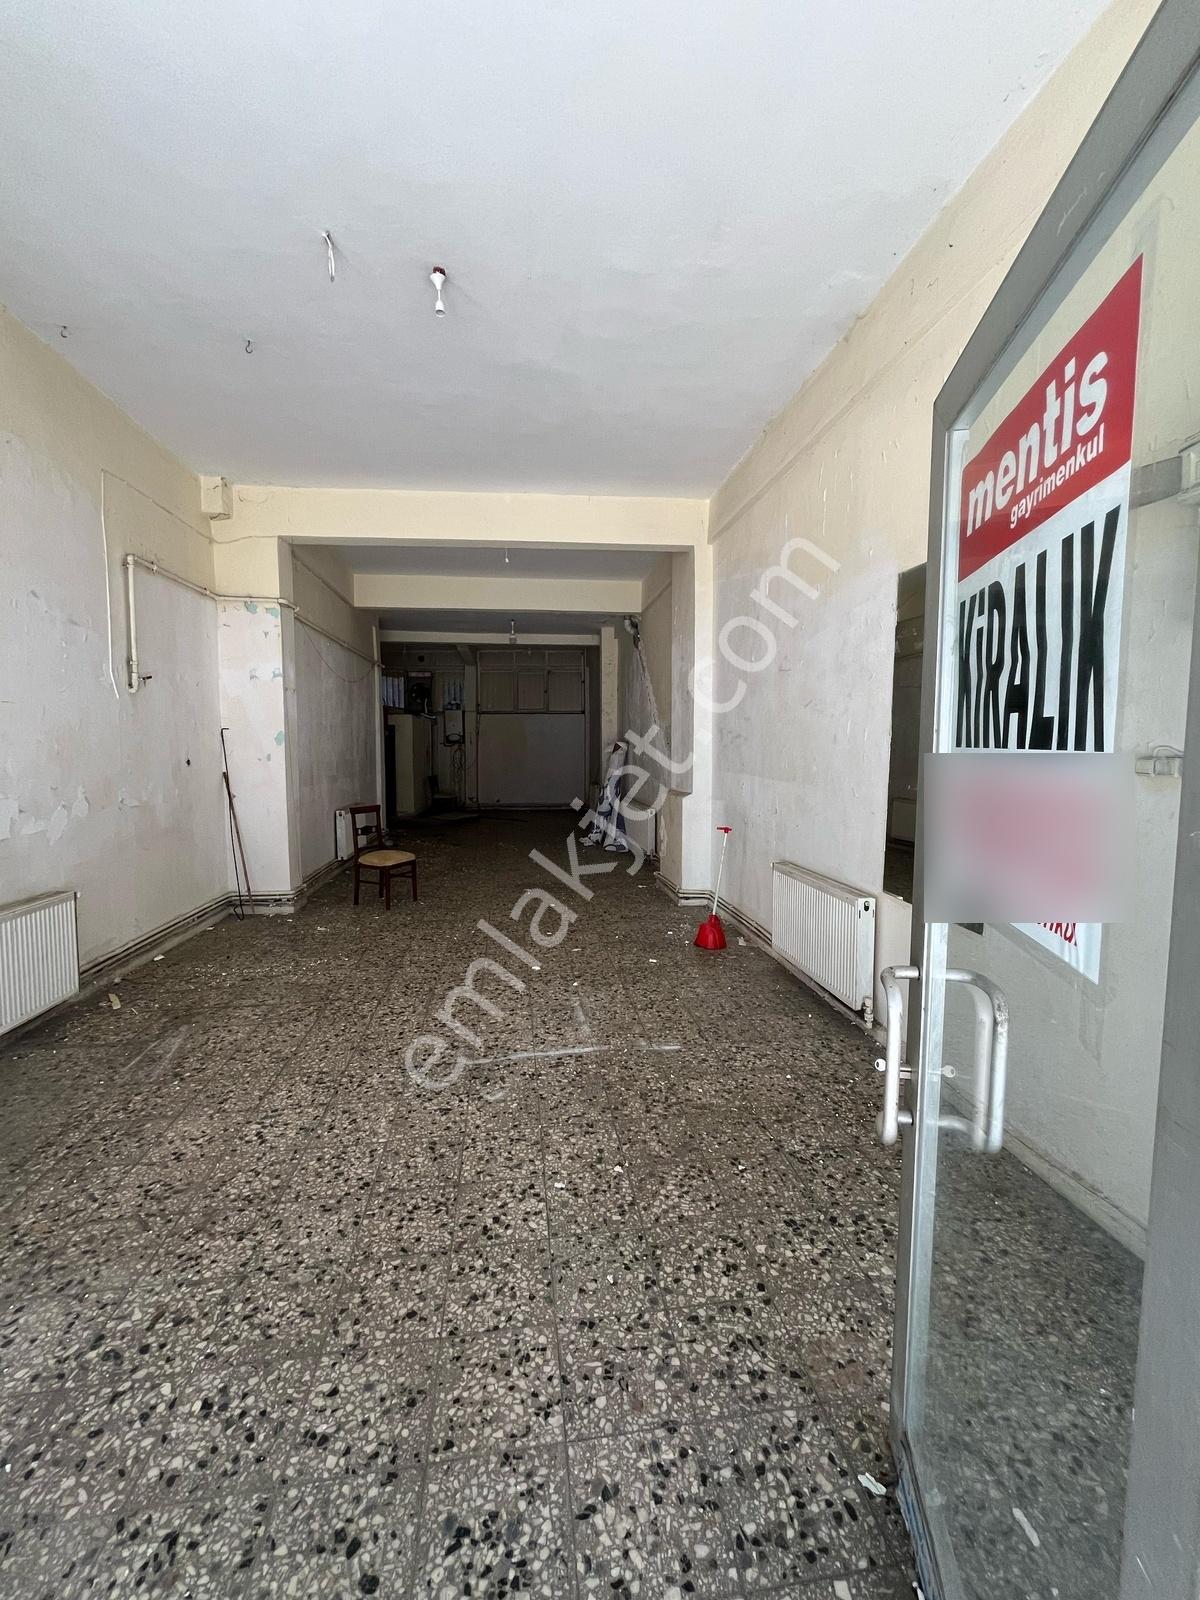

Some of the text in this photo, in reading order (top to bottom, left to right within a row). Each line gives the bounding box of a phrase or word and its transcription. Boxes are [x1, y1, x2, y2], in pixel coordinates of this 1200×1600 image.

[966, 351, 1108, 538] mentis
[1010, 423, 1104, 529] gayrimenkul
[955, 504, 1122, 753] KİRALIK
